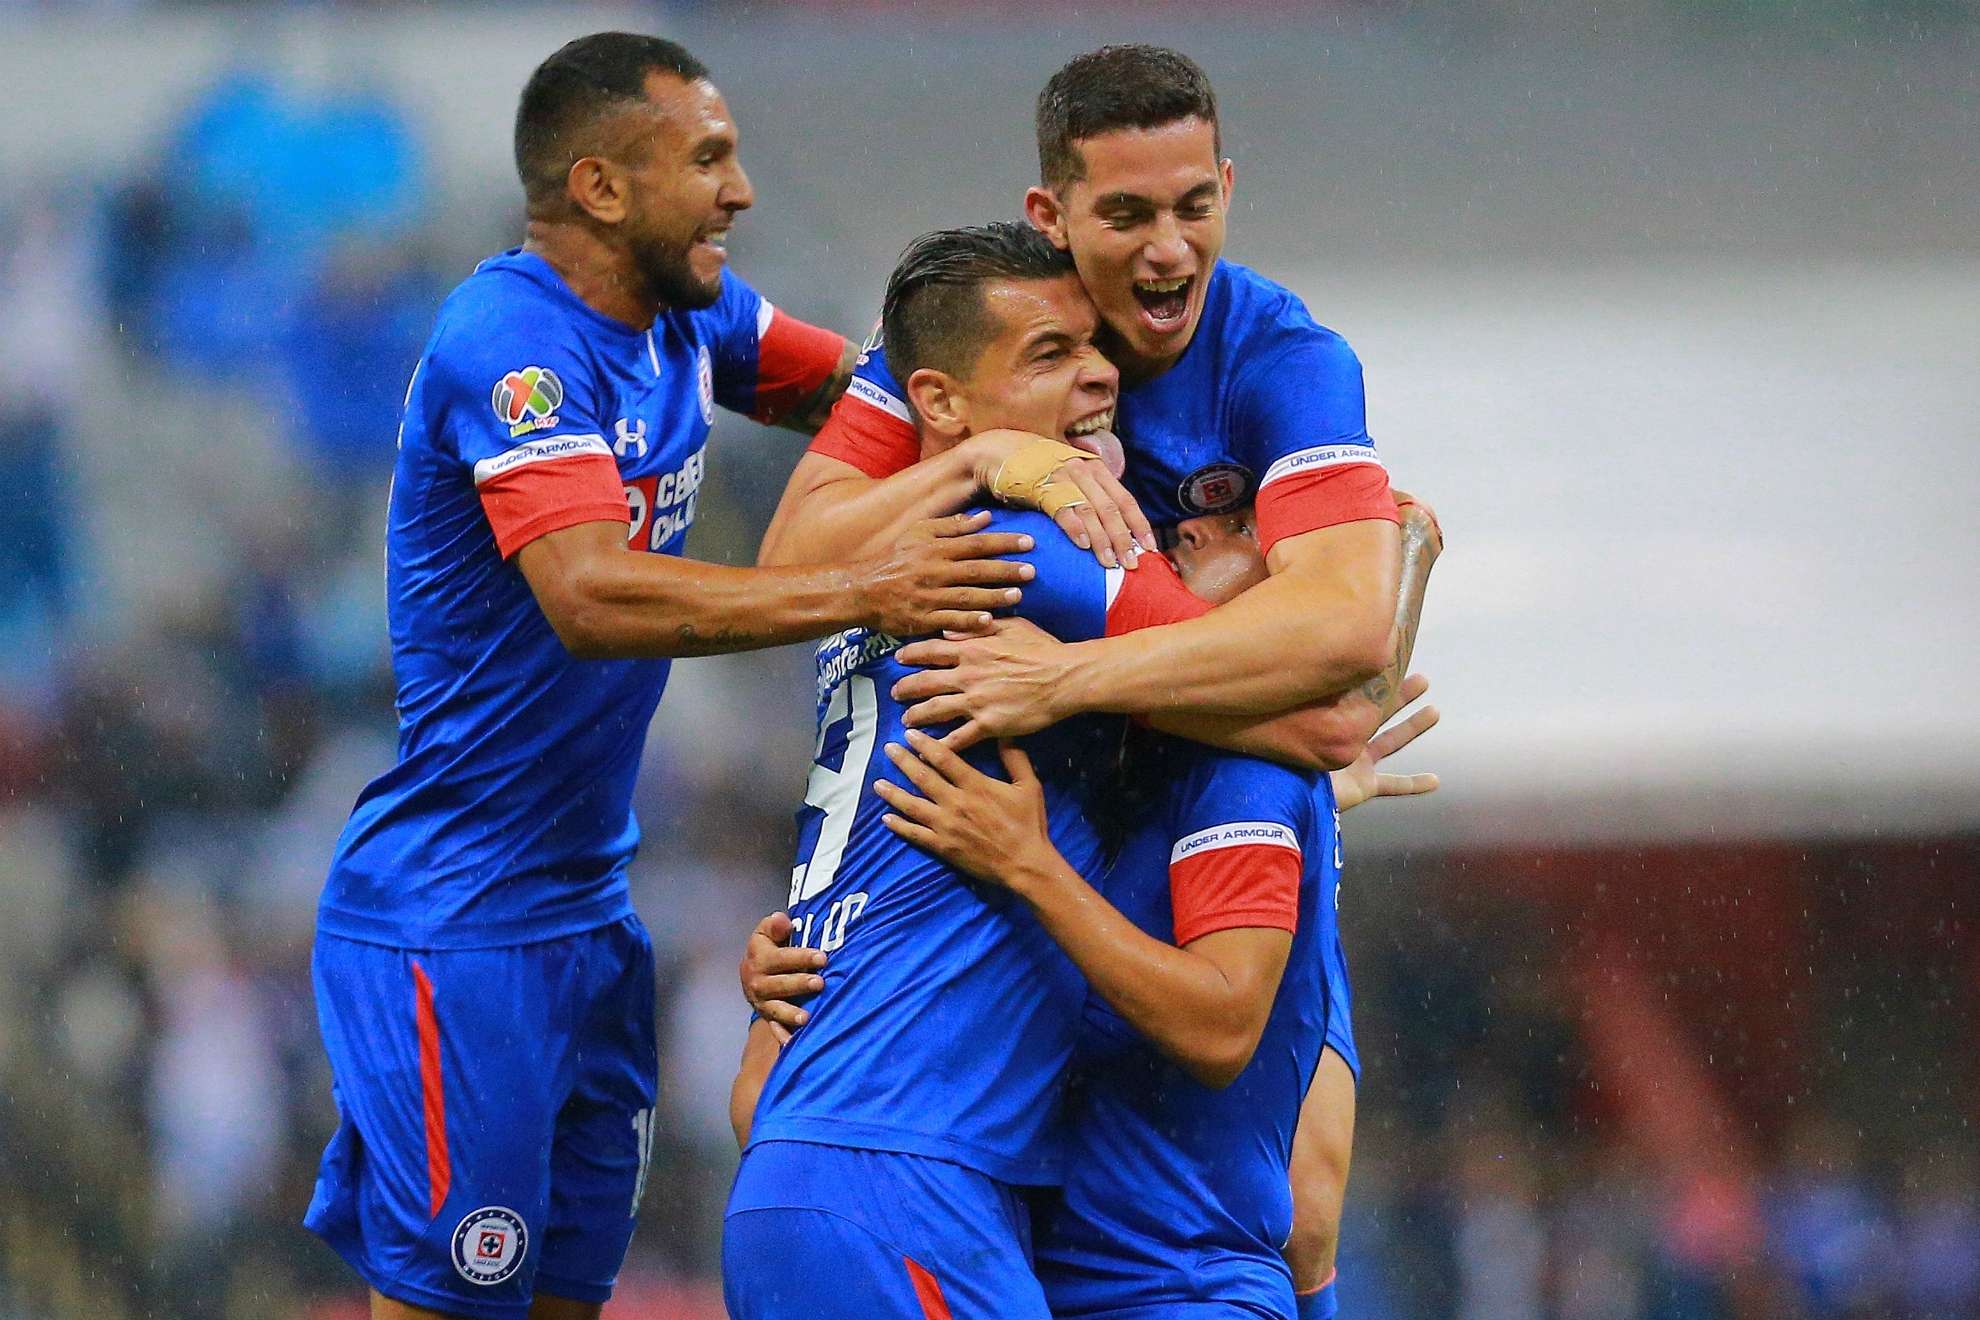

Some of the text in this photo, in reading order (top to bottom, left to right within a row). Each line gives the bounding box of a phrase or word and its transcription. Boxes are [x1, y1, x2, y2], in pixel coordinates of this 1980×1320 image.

[492, 440, 593, 470] UNDER ARMOUR
[1290, 451, 1336, 467] UNDER
[1181, 828, 1283, 853] UNDER ARMOUR
